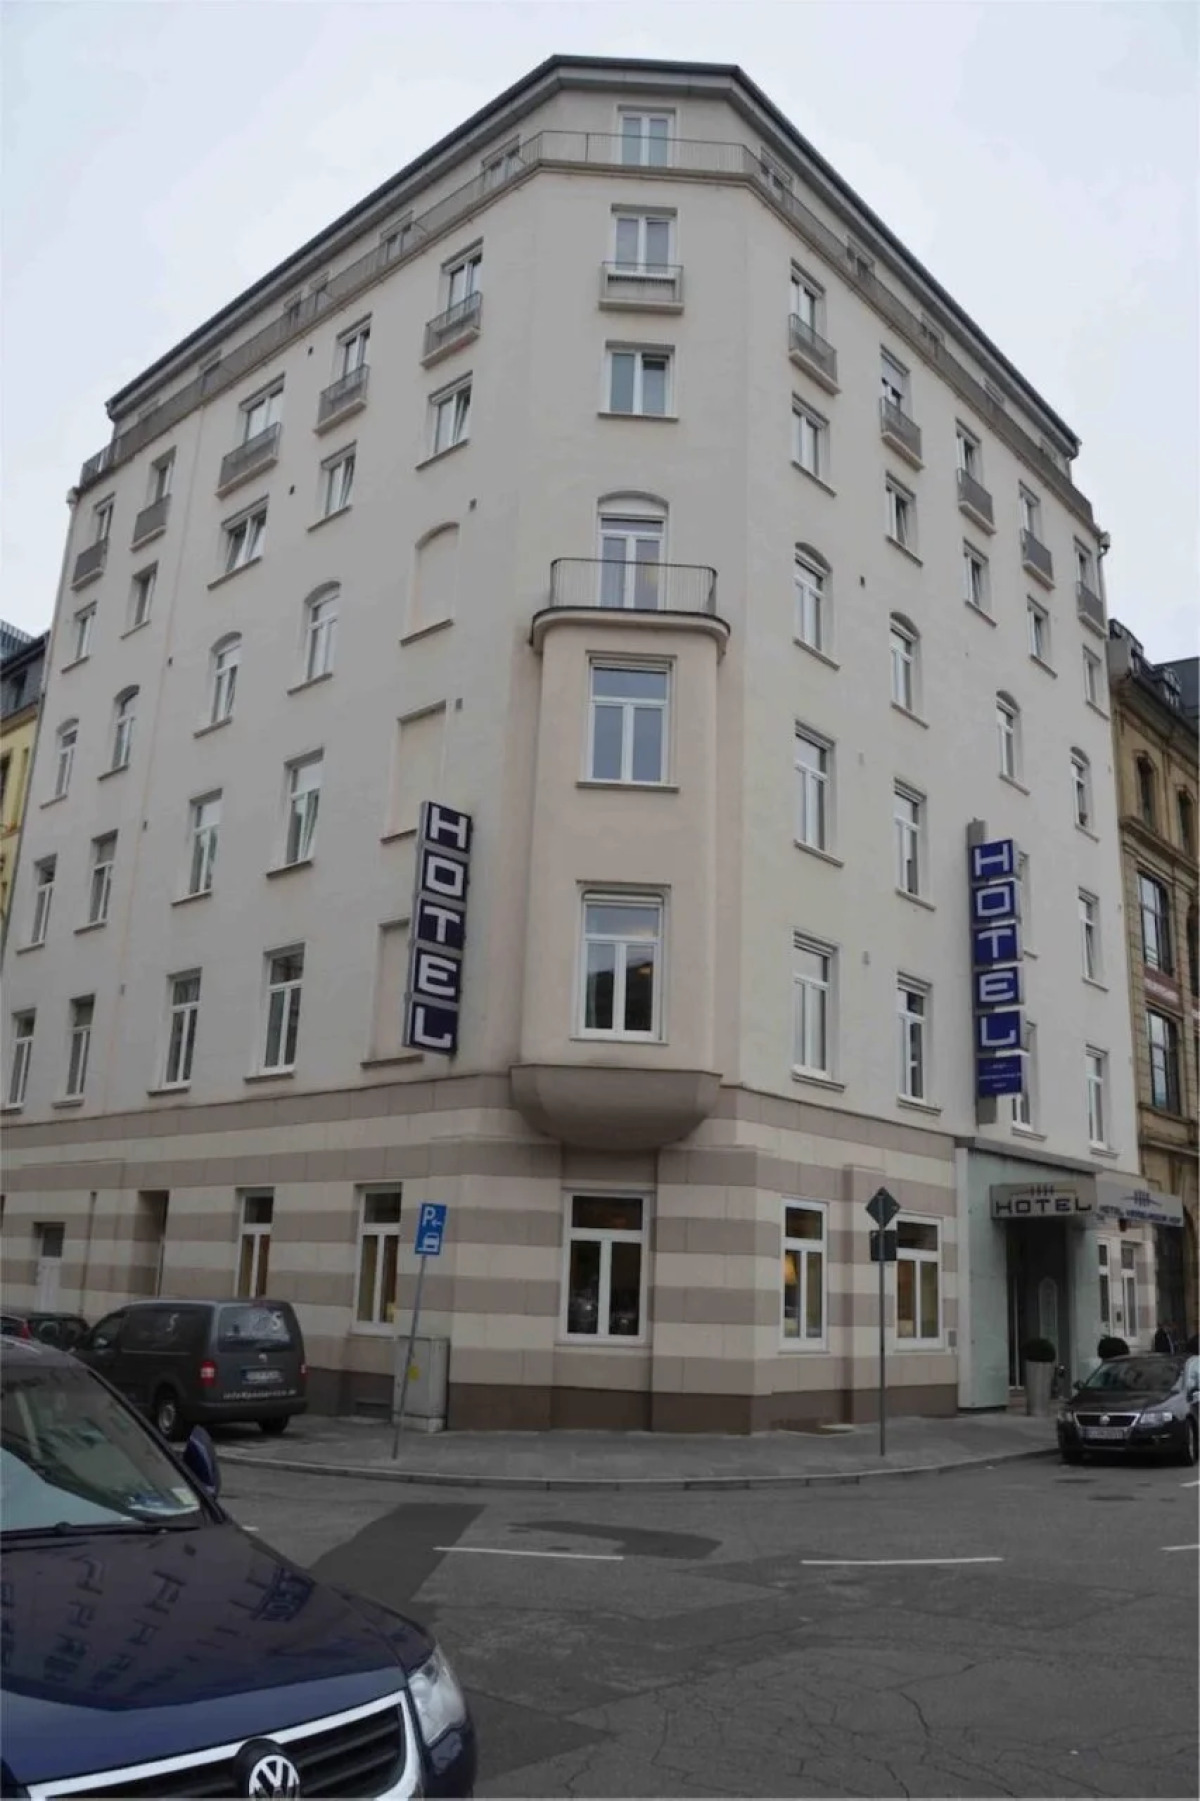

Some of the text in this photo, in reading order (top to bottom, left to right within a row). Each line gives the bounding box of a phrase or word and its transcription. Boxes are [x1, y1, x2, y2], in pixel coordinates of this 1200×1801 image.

[414, 804, 468, 1048] HOTEL
[974, 842, 1017, 1048] HOTEL
[422, 1206, 436, 1227] P
[995, 1197, 1092, 1215] HOTEL
